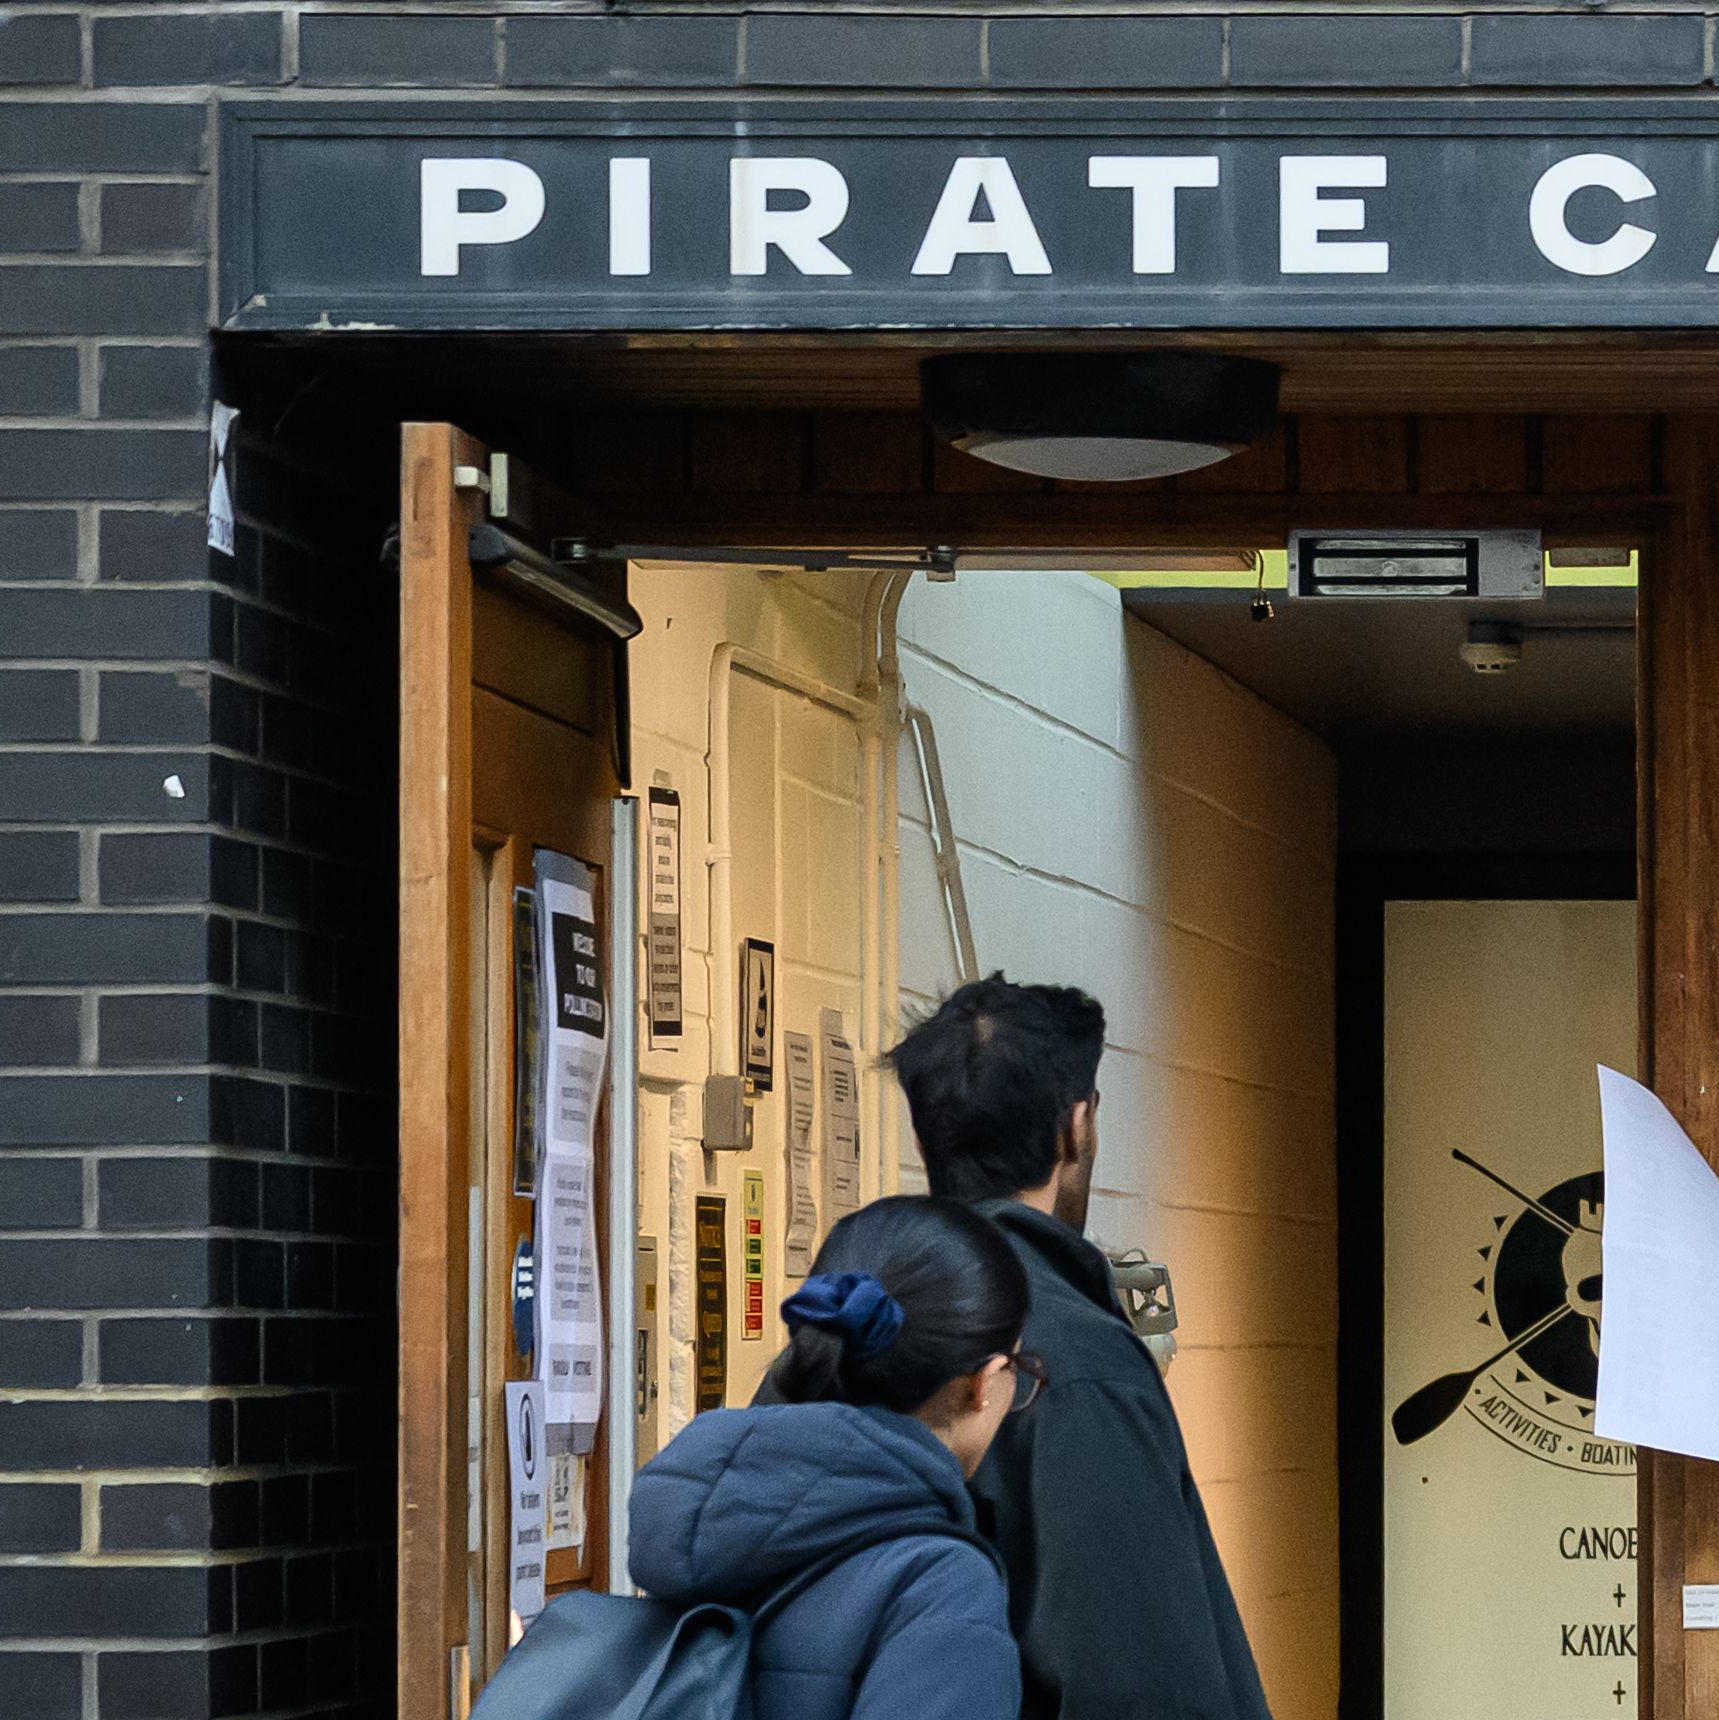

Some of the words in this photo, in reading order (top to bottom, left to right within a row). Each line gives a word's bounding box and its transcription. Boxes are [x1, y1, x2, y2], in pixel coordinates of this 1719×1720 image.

[418, 152, 1392, 278] PIRATE
[1479, 1396, 1562, 1454] ACTIVITIES
[1559, 1526, 1638, 1560] CANOE
[1561, 1624, 1638, 1656] KAYAK
